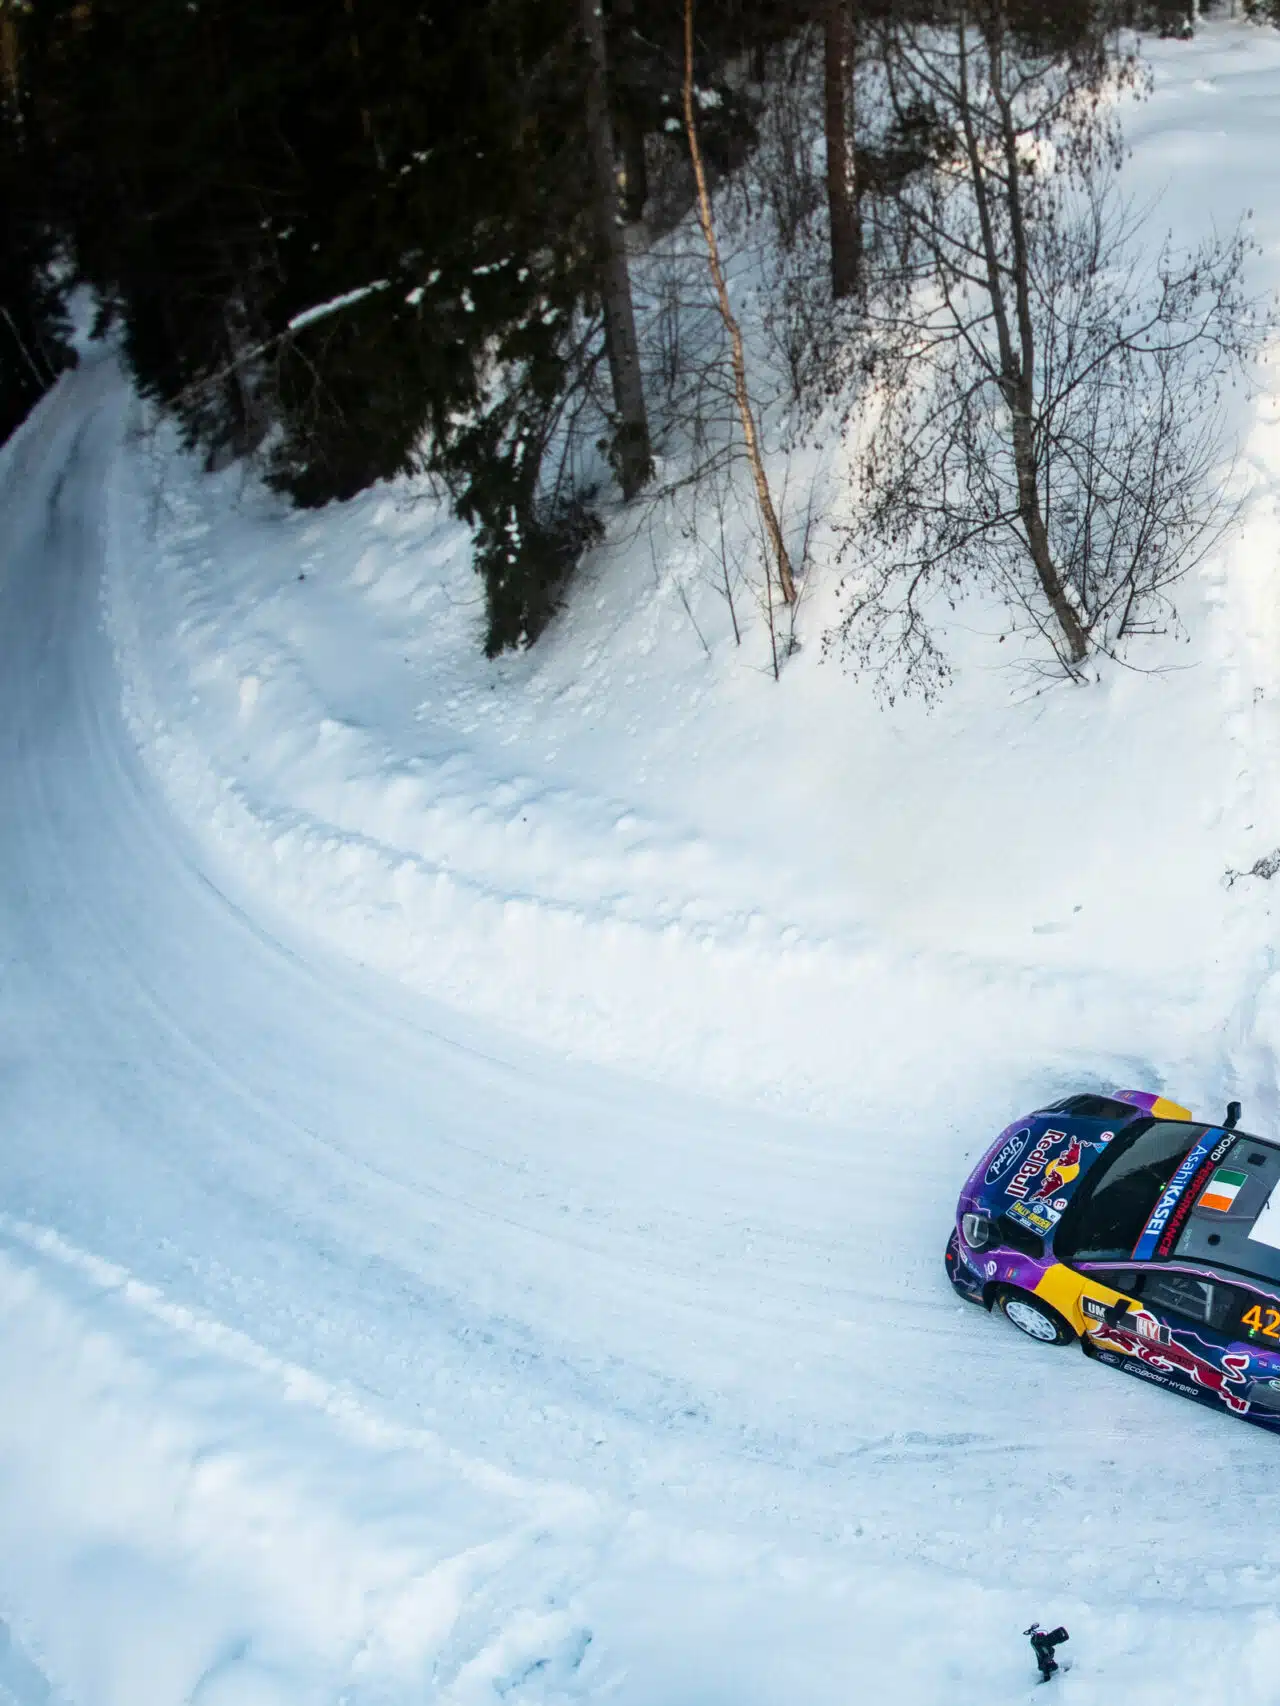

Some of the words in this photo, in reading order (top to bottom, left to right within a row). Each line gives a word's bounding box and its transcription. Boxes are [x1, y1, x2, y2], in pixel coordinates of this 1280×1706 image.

[990, 1135, 1024, 1175] Ford
[1210, 1133, 1237, 1162] FORD
[1012, 1202, 1030, 1217] RALLY
[1028, 1212, 1053, 1231] SWEDEN
[1158, 1160, 1215, 1257] PERFORMANCE
[1123, 1363, 1169, 1384] ECOBOOST
[1168, 1380, 1199, 1396] HYBRID
